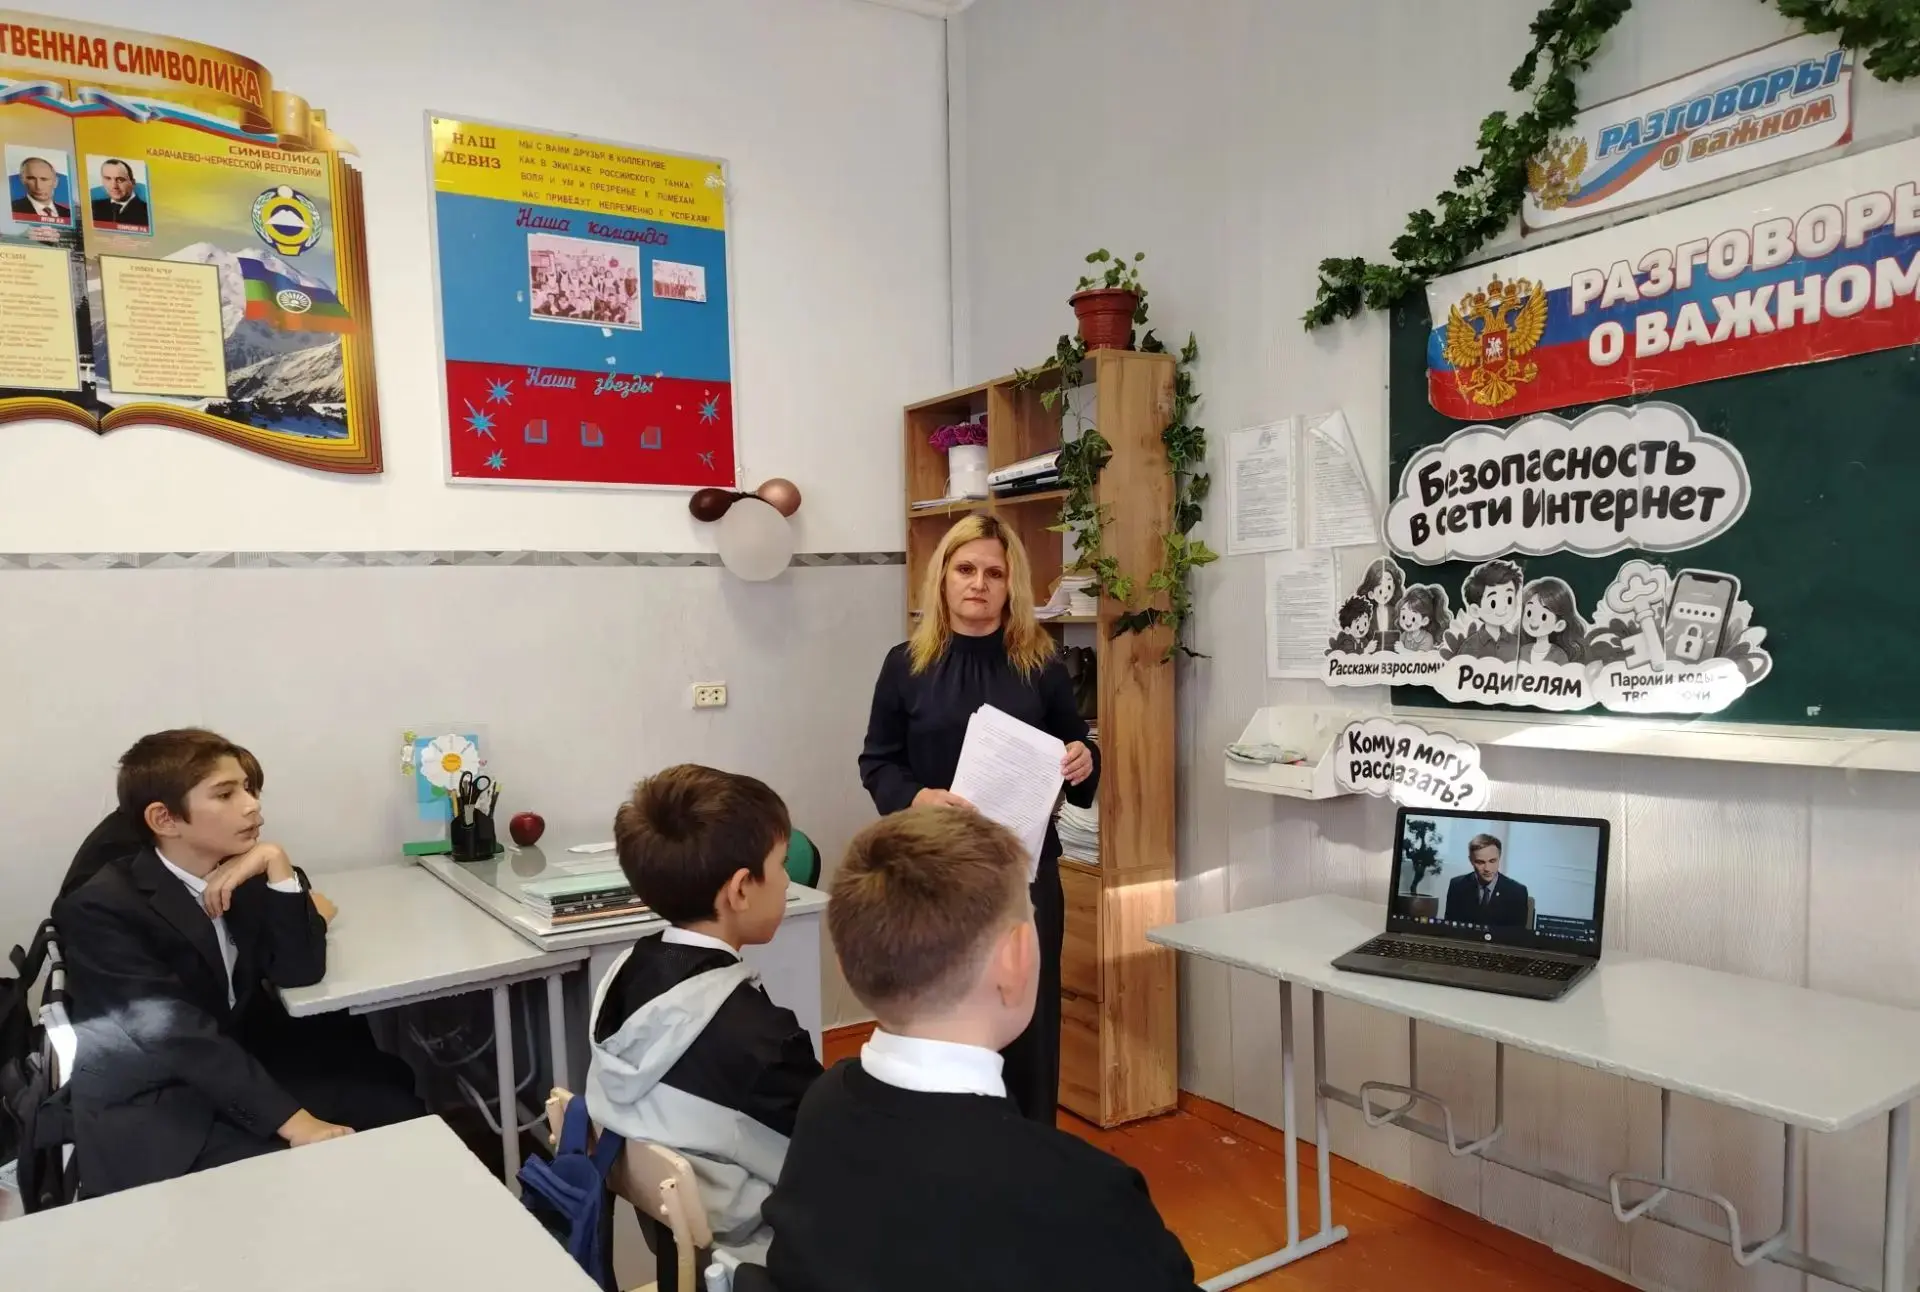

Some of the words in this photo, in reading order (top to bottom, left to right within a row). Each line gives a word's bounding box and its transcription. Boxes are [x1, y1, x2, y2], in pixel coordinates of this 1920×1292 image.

[0, 23, 108, 69] ТВЕННАЯ
[113, 41, 263, 108] СИМВОЛИКА
[1596, 49, 1847, 160] РАЗГОВОРЫ
[452, 132, 496, 149] НАШ
[1687, 95, 1838, 163] важном
[146, 147, 262, 171] КАРАЧАЕВО-ЧЕРКЕССКОЙ
[264, 163, 322, 178] РЕСПУБЛИКИ
[228, 145, 321, 166] СИМВОЛИКА
[441, 151, 501, 169] ДЕВИЗ
[519, 140, 533, 150] МЫ
[536, 143, 542, 151] С
[545, 144, 570, 155] ВАМИ
[573, 148, 605, 161] ДРУЗЬЯ
[616, 155, 667, 170] КОЛЛЕКТИВЕ
[519, 155, 536, 165] КАК
[541, 158, 547, 167] В
[552, 161, 592, 174] ЭКИПАЖЕ
[600, 168, 656, 184] РОССИЙСКОГО
[521, 172, 544, 183] ВОЛЯ
[549, 176, 556, 184] И
[562, 178, 574, 187] УМ
[579, 180, 585, 188] И
[590, 183, 636, 198] ПРЕЗРЕНЬЕ
[522, 189, 540, 199] НАС
[546, 193, 591, 207] ПРИВЕДУТ
[599, 200, 654, 216] НЕПРЕМЕННО
[516, 207, 571, 232] Наша
[587, 220, 669, 246] команда
[1588, 323, 1625, 367] О
[1634, 250, 1920, 358] ВАЖНОМ
[525, 366, 577, 390] Наши
[593, 370, 654, 399] звезды
[1418, 440, 1697, 507] Безопасность
[1410, 512, 1430, 546] в
[1435, 496, 1513, 536] сети
[1522, 485, 1726, 533] Интернет
[1328, 658, 1380, 676] Расскажи
[1458, 664, 1583, 698] Родителям
[1610, 672, 1664, 689] Пароли
[1664, 672, 1673, 684] и
[1348, 730, 1395, 759] Кому
[1413, 743, 1472, 781] могу
[1350, 759, 1474, 807] рассказать?
